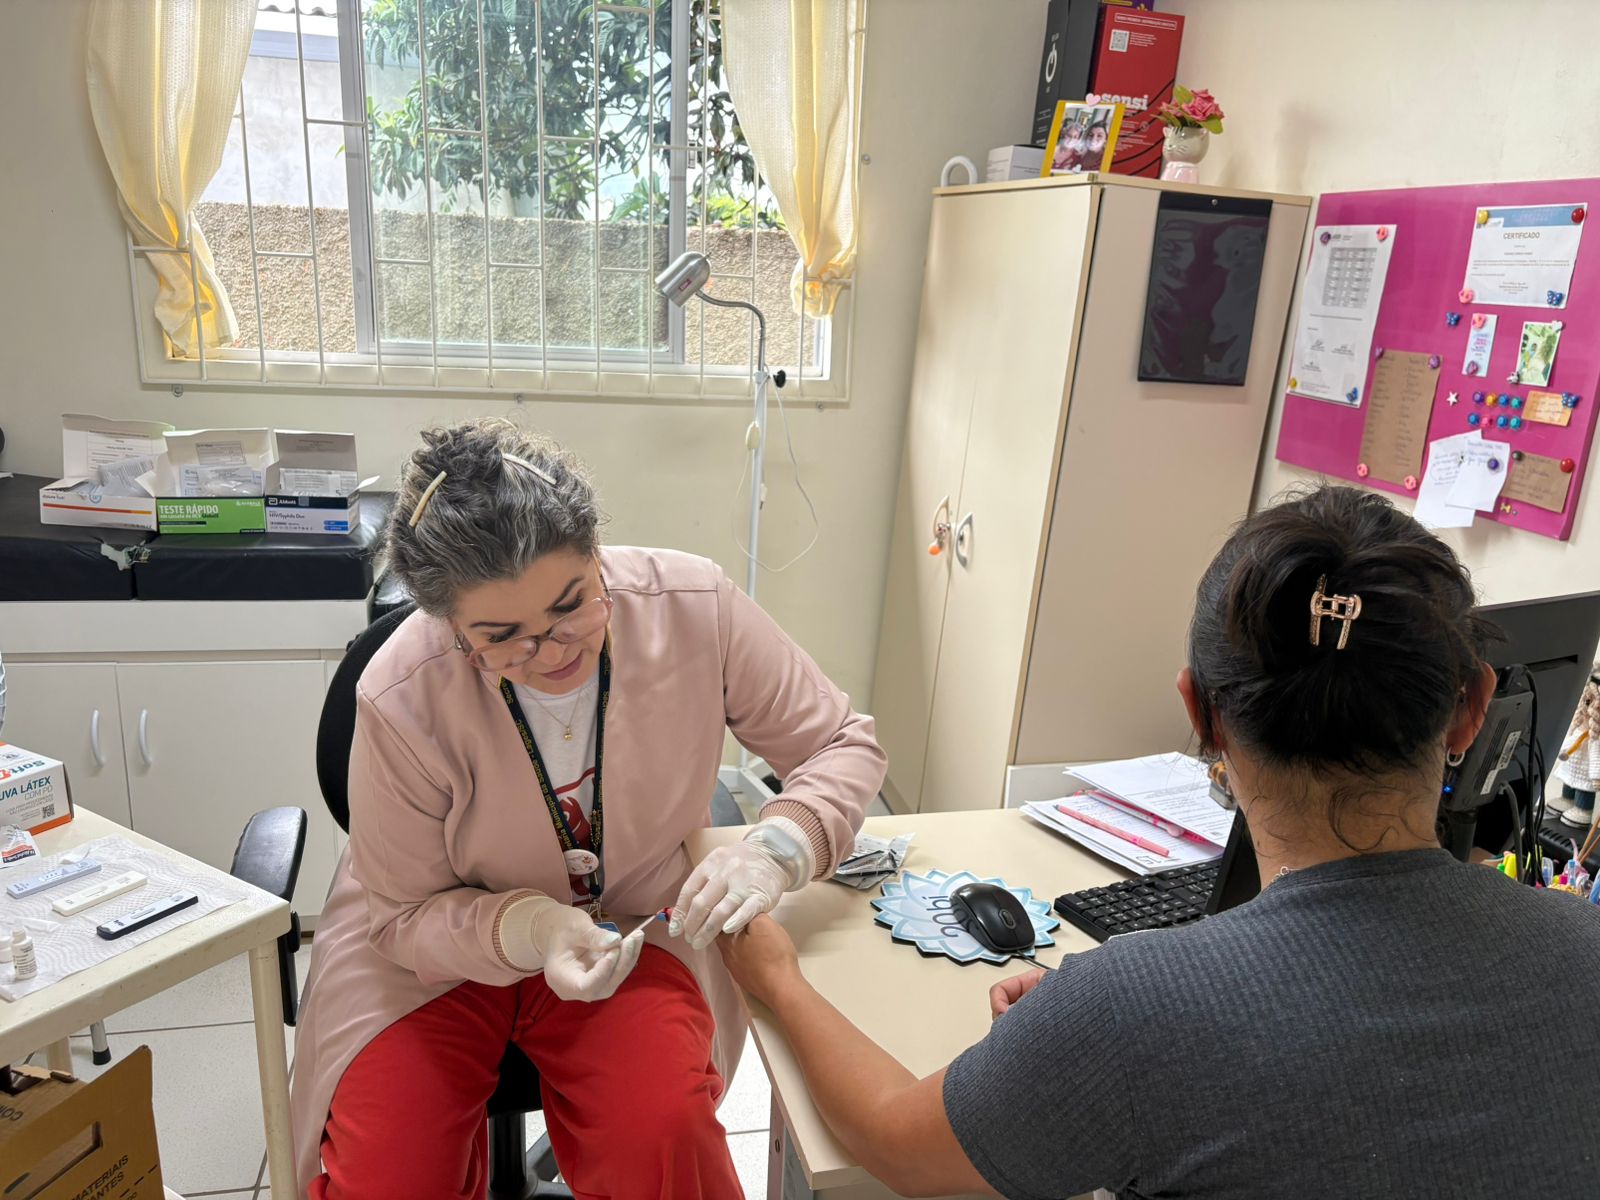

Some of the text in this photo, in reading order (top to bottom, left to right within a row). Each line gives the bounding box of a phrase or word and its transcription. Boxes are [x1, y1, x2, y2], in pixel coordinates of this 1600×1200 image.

[1101, 93, 1149, 110] sensi
[1503, 232, 1540, 240] CERTIFICADO
[159, 503, 219, 514] TESTE RÁPIDO
[20, 776, 51, 794] LÁTEX
[545, 794, 564, 829] Municipal
